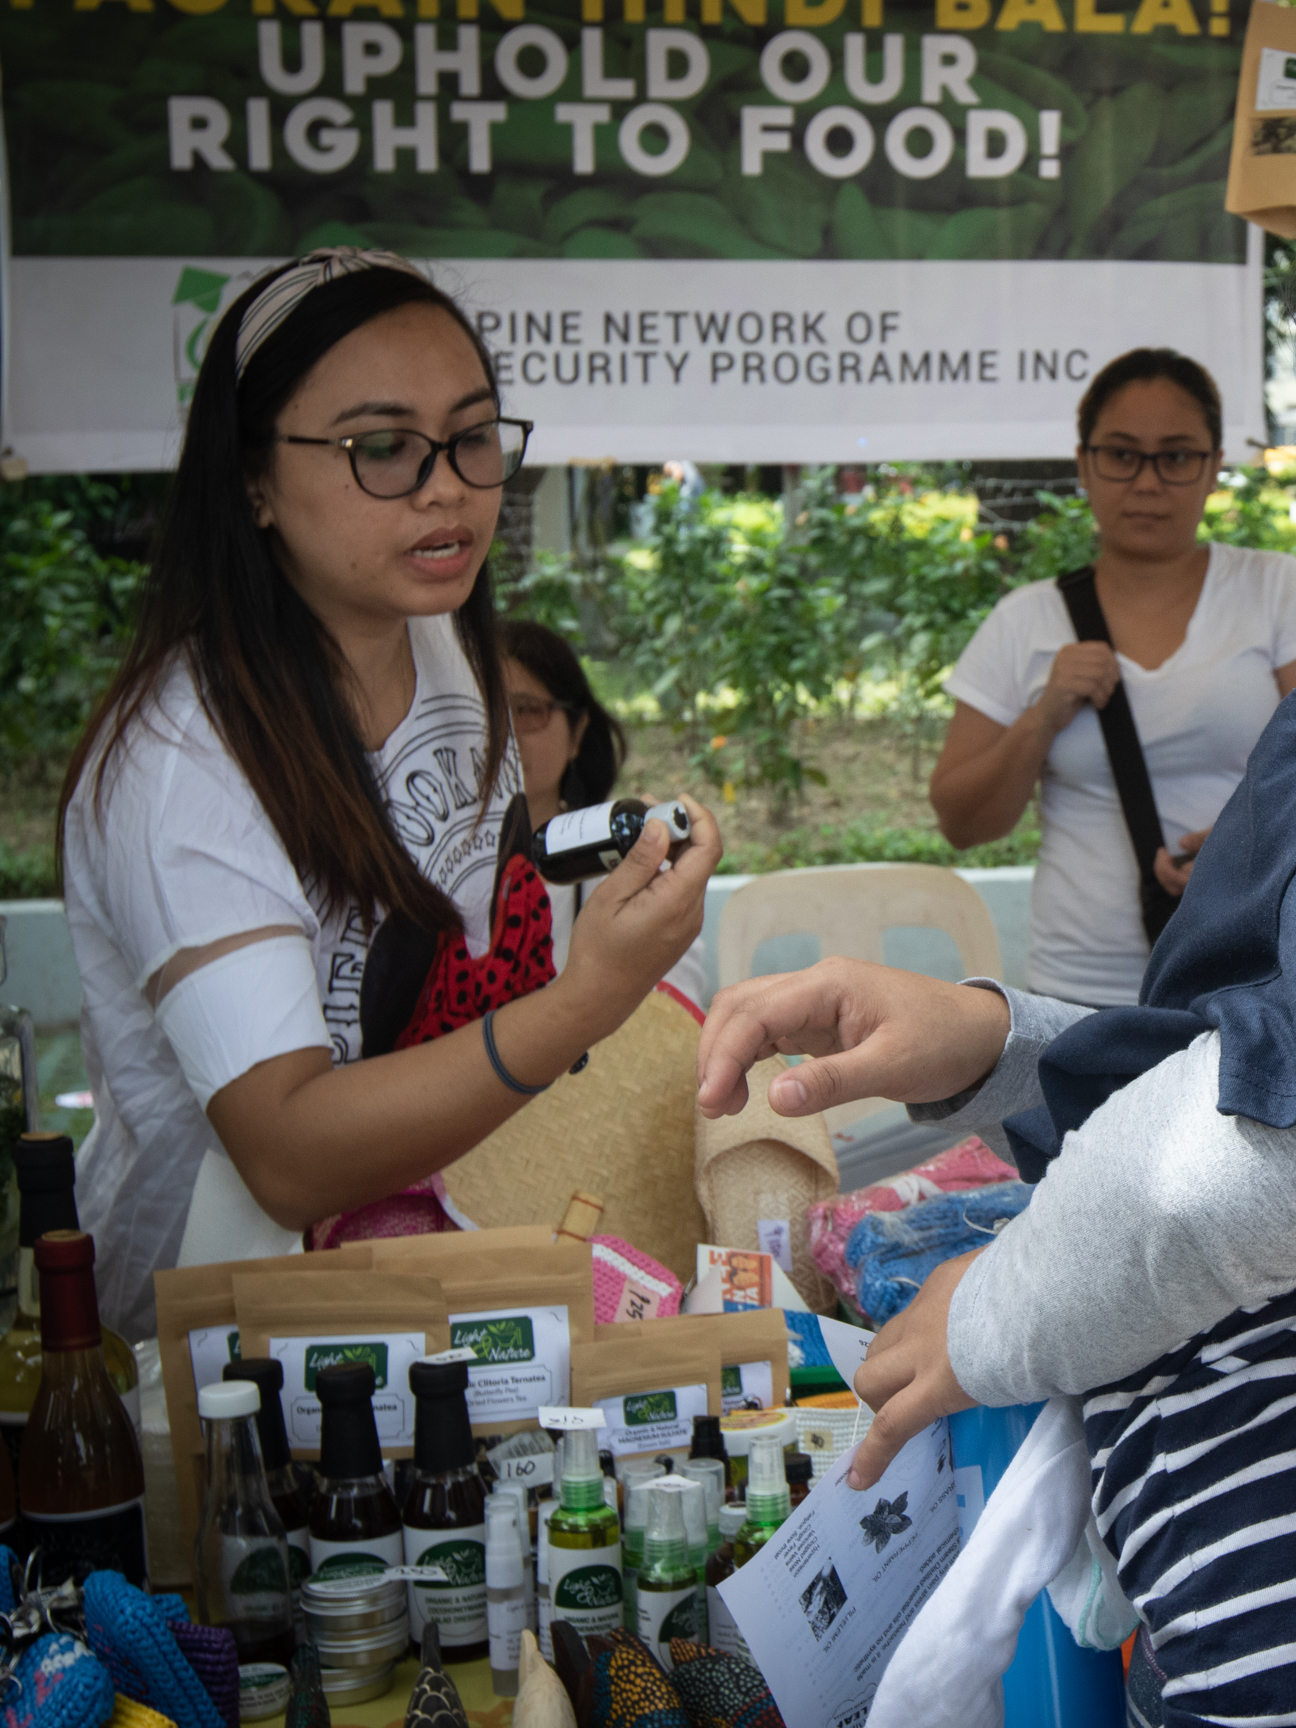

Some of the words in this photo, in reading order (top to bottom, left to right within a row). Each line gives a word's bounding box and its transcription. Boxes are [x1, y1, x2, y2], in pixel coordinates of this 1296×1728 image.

[257, 19, 710, 100] UPHOLD
[760, 29, 980, 105] OUR
[168, 96, 507, 175] RIGHT
[554, 102, 691, 177] TO
[740, 106, 1062, 179] FOOD!
[603, 310, 827, 345] NETWORK
[845, 310, 901, 344] OF
[494, 351, 690, 386] ECURITY
[710, 349, 999, 386] PROGRAMME
[507, 1459, 536, 1479] 160
[939, 1542, 957, 1564] Steam
[919, 1561, 941, 1586] Distilled
[926, 1574, 939, 1590] pain
[901, 1584, 920, 1614] essential
[914, 1588, 928, 1608] stress
[892, 1612, 902, 1624] oils
[905, 1606, 914, 1621] and
[876, 1635, 884, 1646] no
[883, 1623, 893, 1637] and
[854, 1644, 876, 1673] synthetic
[856, 1663, 872, 1682] made
